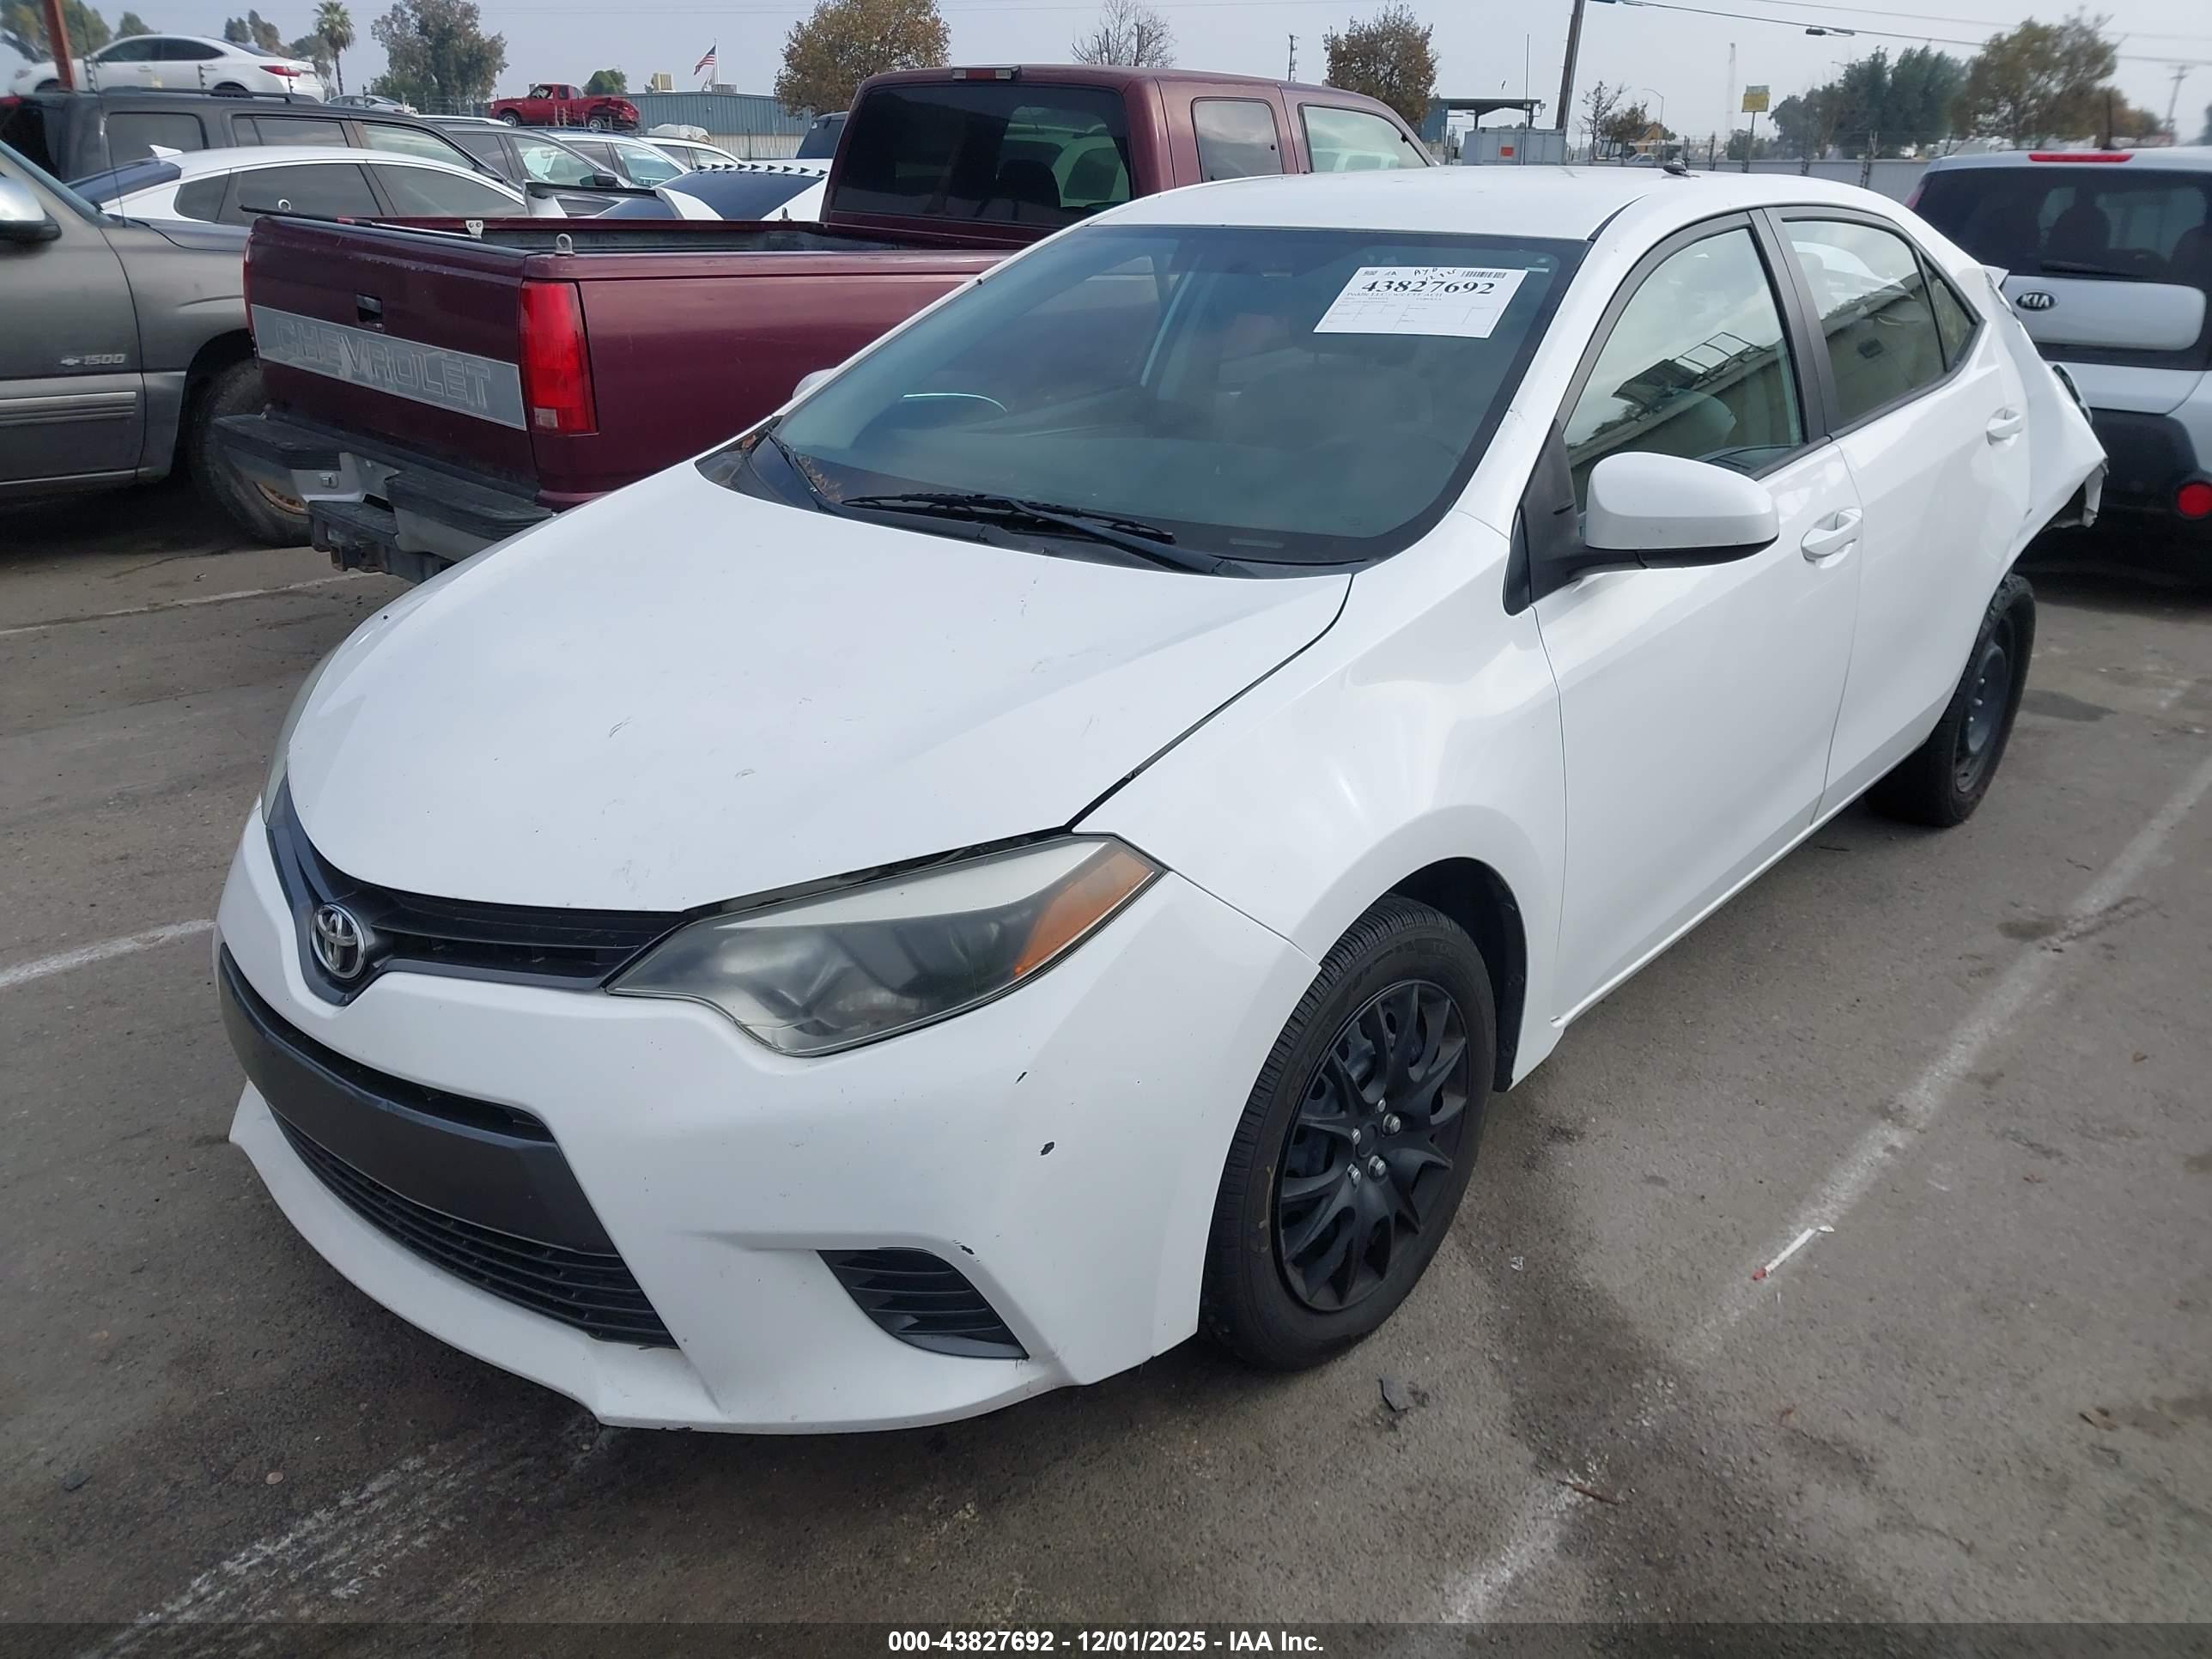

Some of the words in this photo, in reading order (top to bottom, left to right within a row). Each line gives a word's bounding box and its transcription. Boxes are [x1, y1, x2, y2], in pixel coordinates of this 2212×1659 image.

[1361, 280, 1495, 295] 43827692
[2021, 293, 2051, 307] KIA
[82, 353, 127, 365] 1500
[274, 317, 491, 410] CHEVROLET
